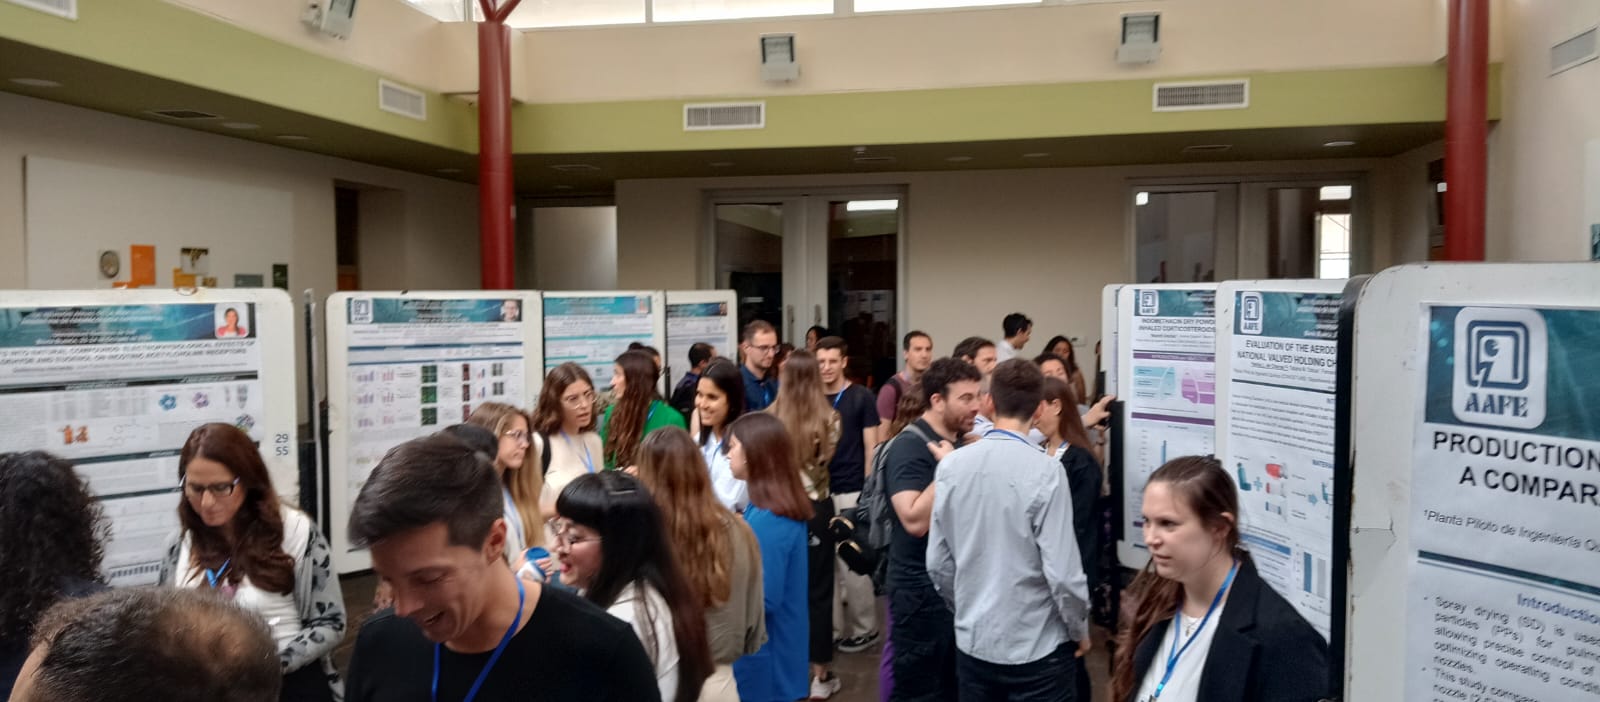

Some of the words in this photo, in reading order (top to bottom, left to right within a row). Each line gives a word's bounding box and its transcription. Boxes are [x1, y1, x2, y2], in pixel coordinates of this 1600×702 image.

[1243, 322, 1260, 331] AAFE
[1238, 351, 1267, 361] NATIONAL
[1269, 353, 1293, 363] VALVED
[1294, 356, 1326, 367] HOLDING
[1245, 340, 1284, 351] EVALUATION
[1285, 343, 1294, 351] OF
[1296, 344, 1310, 352] THE
[1465, 392, 1529, 418] AAFE
[275, 433, 289, 444] 29
[1433, 431, 1600, 473] PRODUCTION
[1459, 465, 1477, 487] A
[1484, 468, 1600, 506] COMPAR
[1466, 516, 1499, 533] Piloto
[1501, 524, 1515, 536] de
[1435, 596, 1467, 615] Spray
[1474, 606, 1510, 626] drying
[1553, 625, 1565, 637] is
[1434, 612, 1480, 631] particles
[1536, 635, 1554, 649] for
[1434, 626, 1478, 648] allowing
[1483, 640, 1525, 658] precise
[1531, 652, 1574, 672] control
[1581, 664, 1595, 677] of
[1434, 640, 1488, 665] optimizing
[1495, 657, 1550, 684] operating
[1432, 684, 1468, 701] nozzle
[1433, 667, 1457, 684] This
[1458, 676, 1488, 695] study
